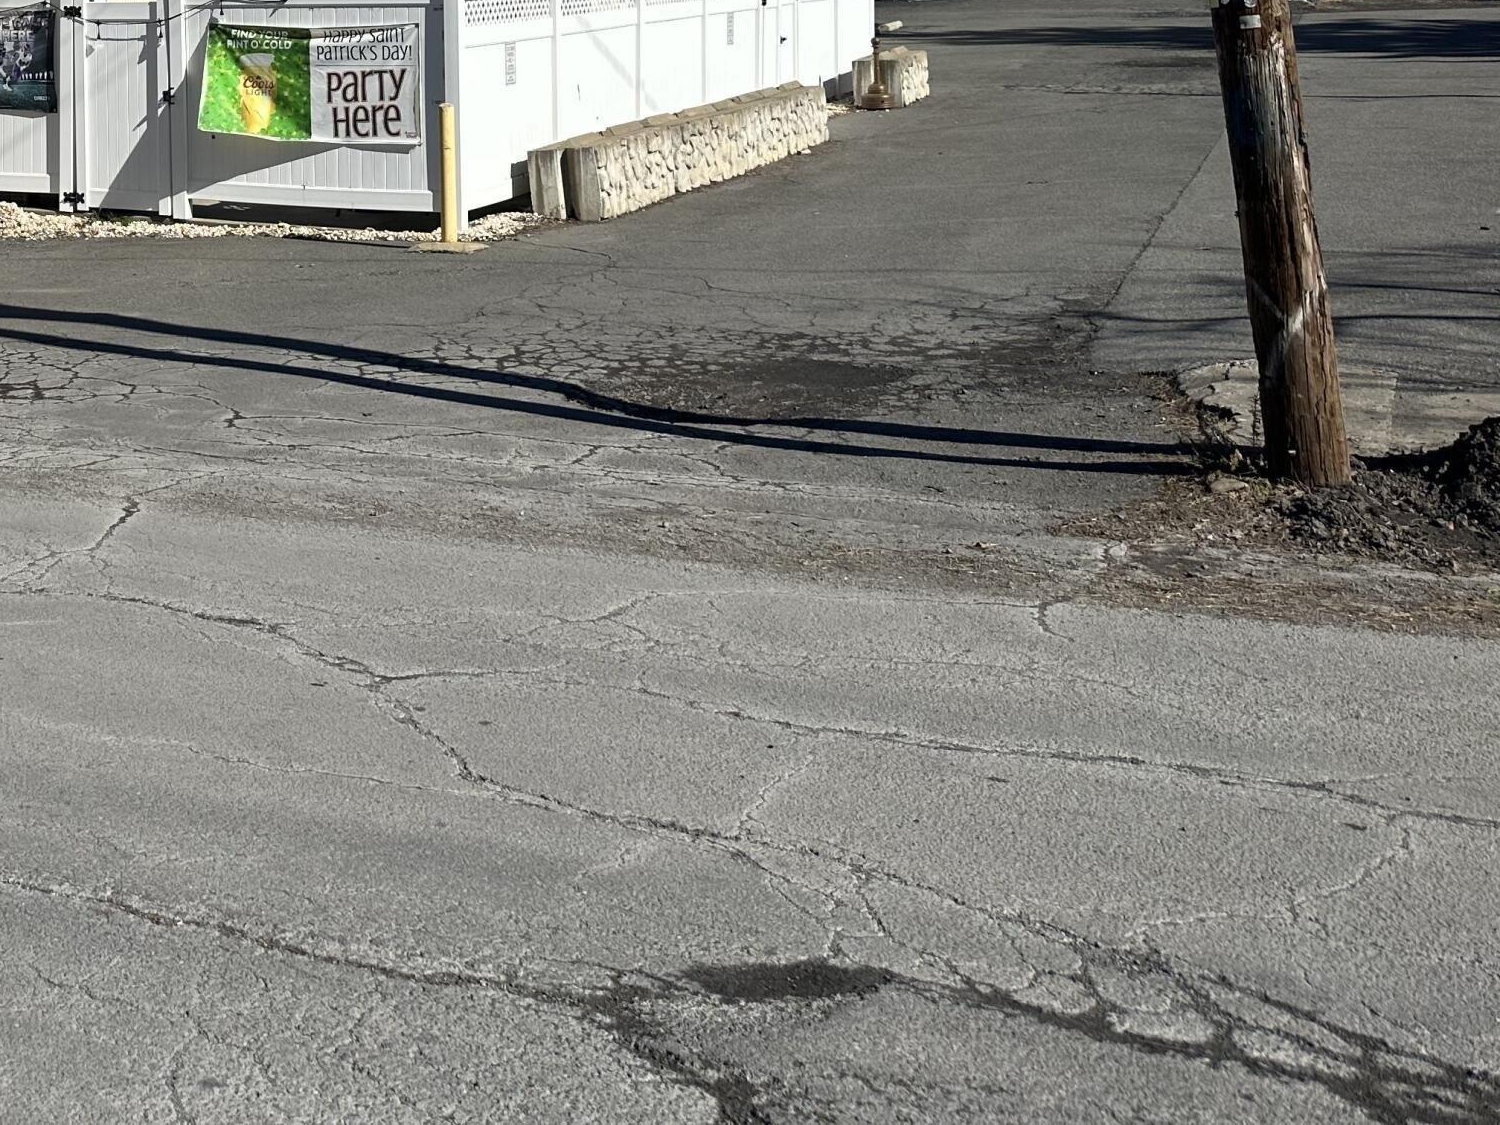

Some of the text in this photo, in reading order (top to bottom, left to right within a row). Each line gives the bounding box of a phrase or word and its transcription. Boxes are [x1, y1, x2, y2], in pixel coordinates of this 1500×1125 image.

[2, 30, 35, 42] HERE
[231, 29, 288, 40] FIND YOUR
[227, 39, 248, 49] PINT
[263, 40, 292, 50] COLD
[243, 76, 275, 89] Coors
[245, 89, 272, 97] LIGHT
